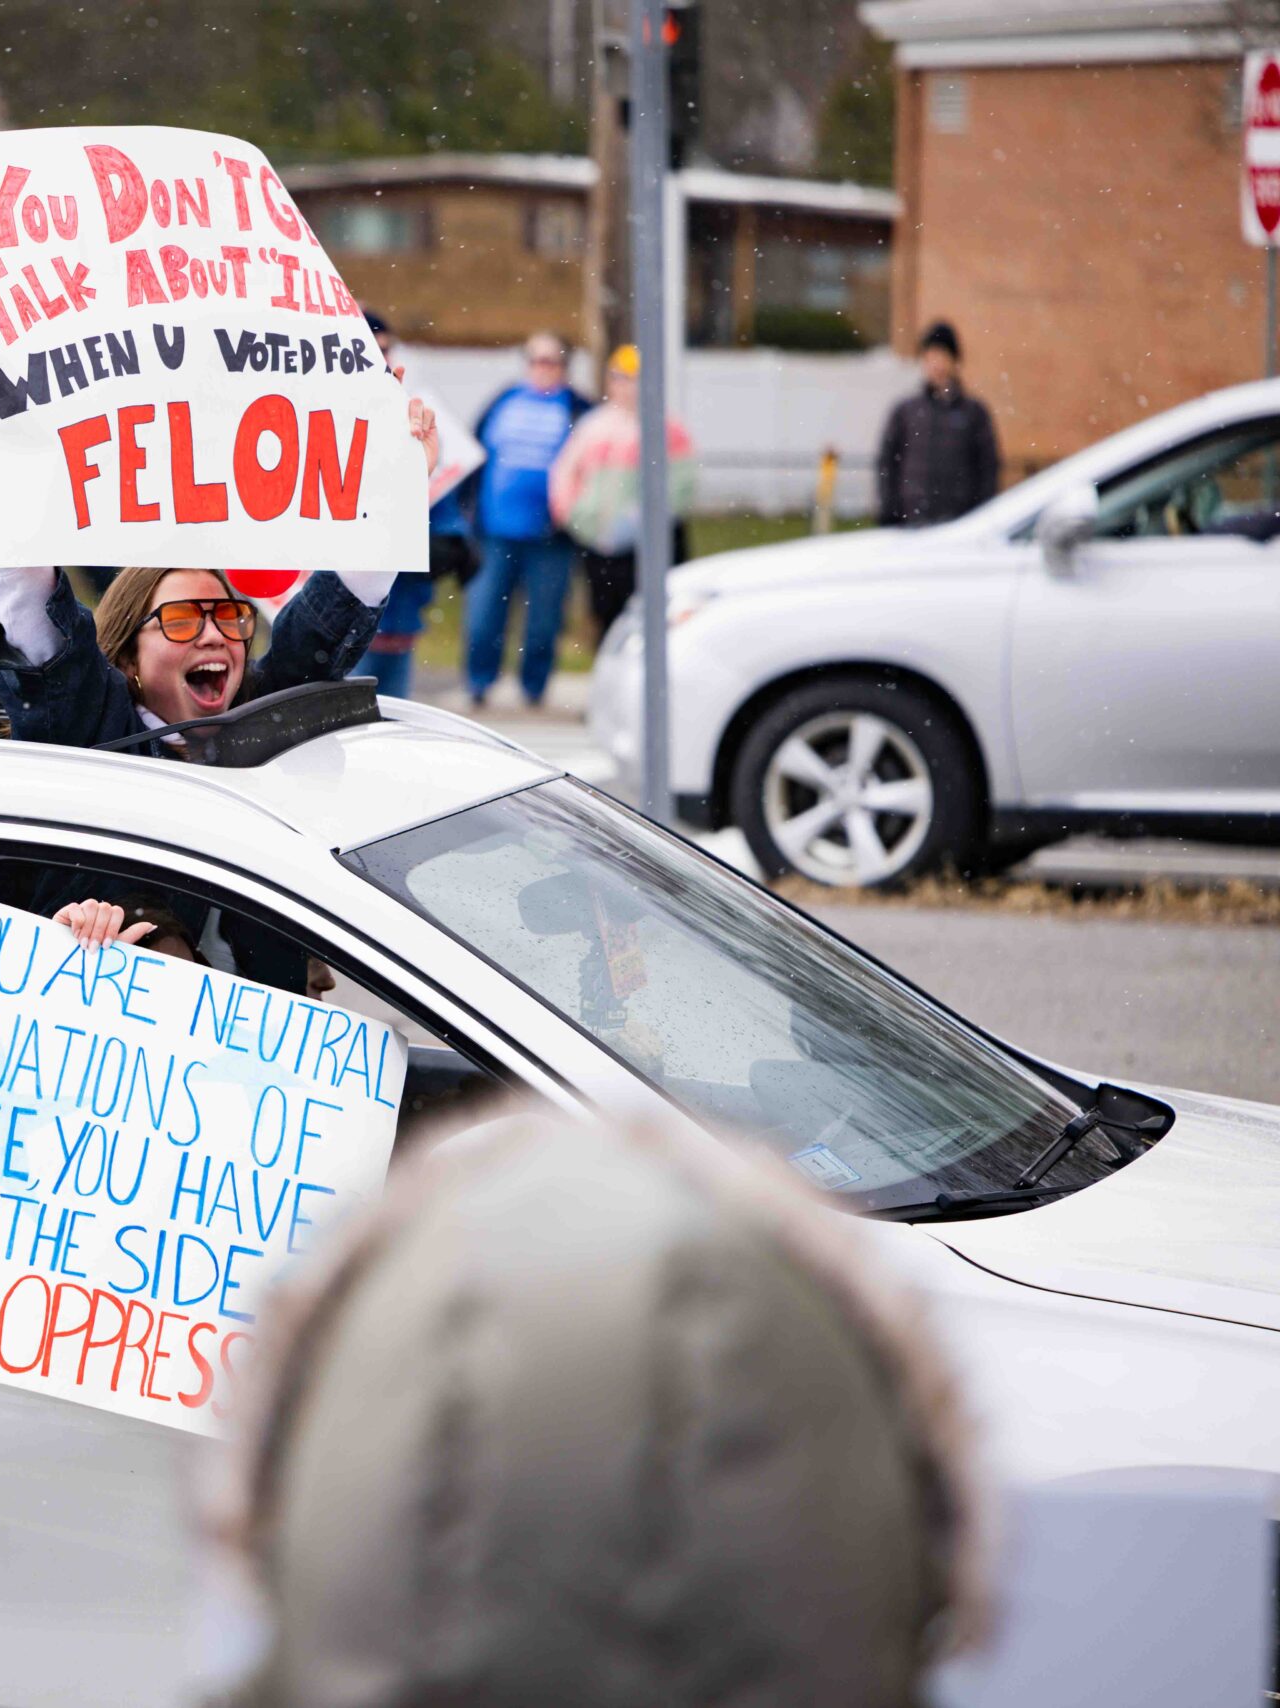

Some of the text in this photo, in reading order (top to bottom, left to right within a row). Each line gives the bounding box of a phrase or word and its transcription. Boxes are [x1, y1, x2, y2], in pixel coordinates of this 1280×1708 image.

[83, 144, 252, 244] DON'T
[126, 244, 251, 308] ABOUT
[153, 324, 185, 371] U
[213, 327, 316, 375] VOTED
[322, 333, 374, 375] FOR
[57, 394, 370, 530] FELON.
[40, 946, 166, 1026] ARE
[188, 974, 396, 1109] NEUTRAL
[51, 1115, 150, 1206] YOU
[169, 1150, 337, 1255] HAVE
[250, 1085, 345, 1176] OF
[0, 1192, 97, 1280] THE
[108, 1224, 265, 1325] SIDE
